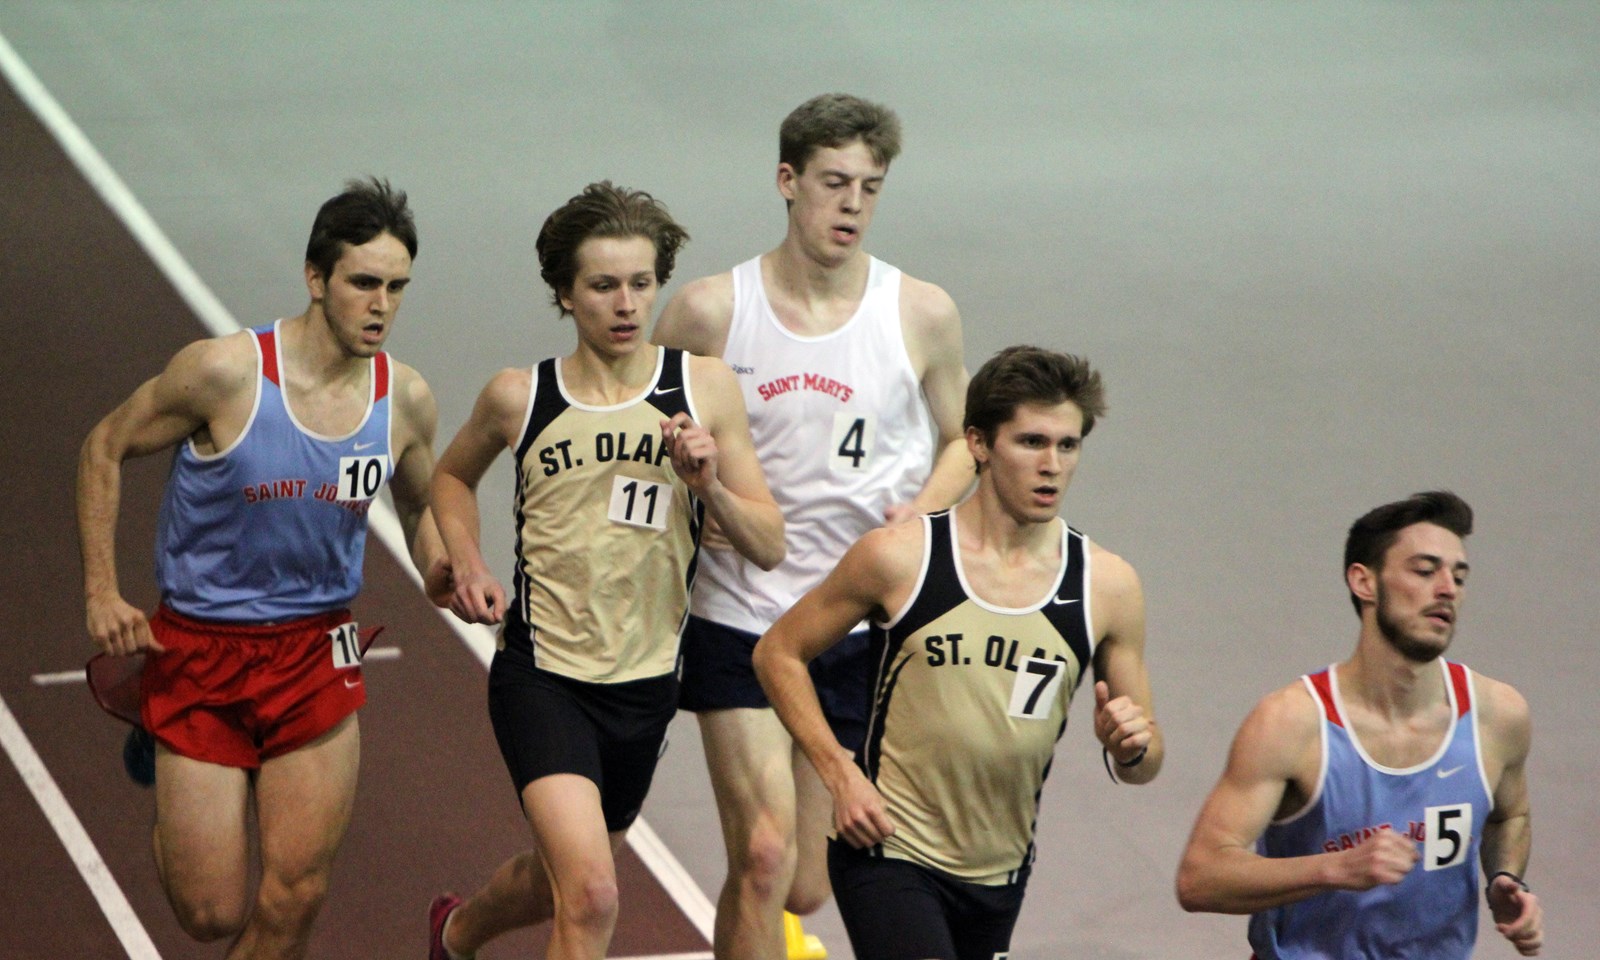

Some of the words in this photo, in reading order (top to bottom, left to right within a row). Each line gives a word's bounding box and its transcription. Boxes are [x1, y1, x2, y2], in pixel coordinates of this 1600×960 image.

[758, 375, 800, 402] SAINT
[539, 439, 583, 477] ST.
[838, 417, 866, 468] 4
[243, 480, 307, 504] SAINT
[345, 458, 382, 498] 10
[622, 481, 659, 524] 11
[925, 633, 971, 667] ST.
[1022, 661, 1059, 714] 7
[1436, 809, 1461, 866] 5
